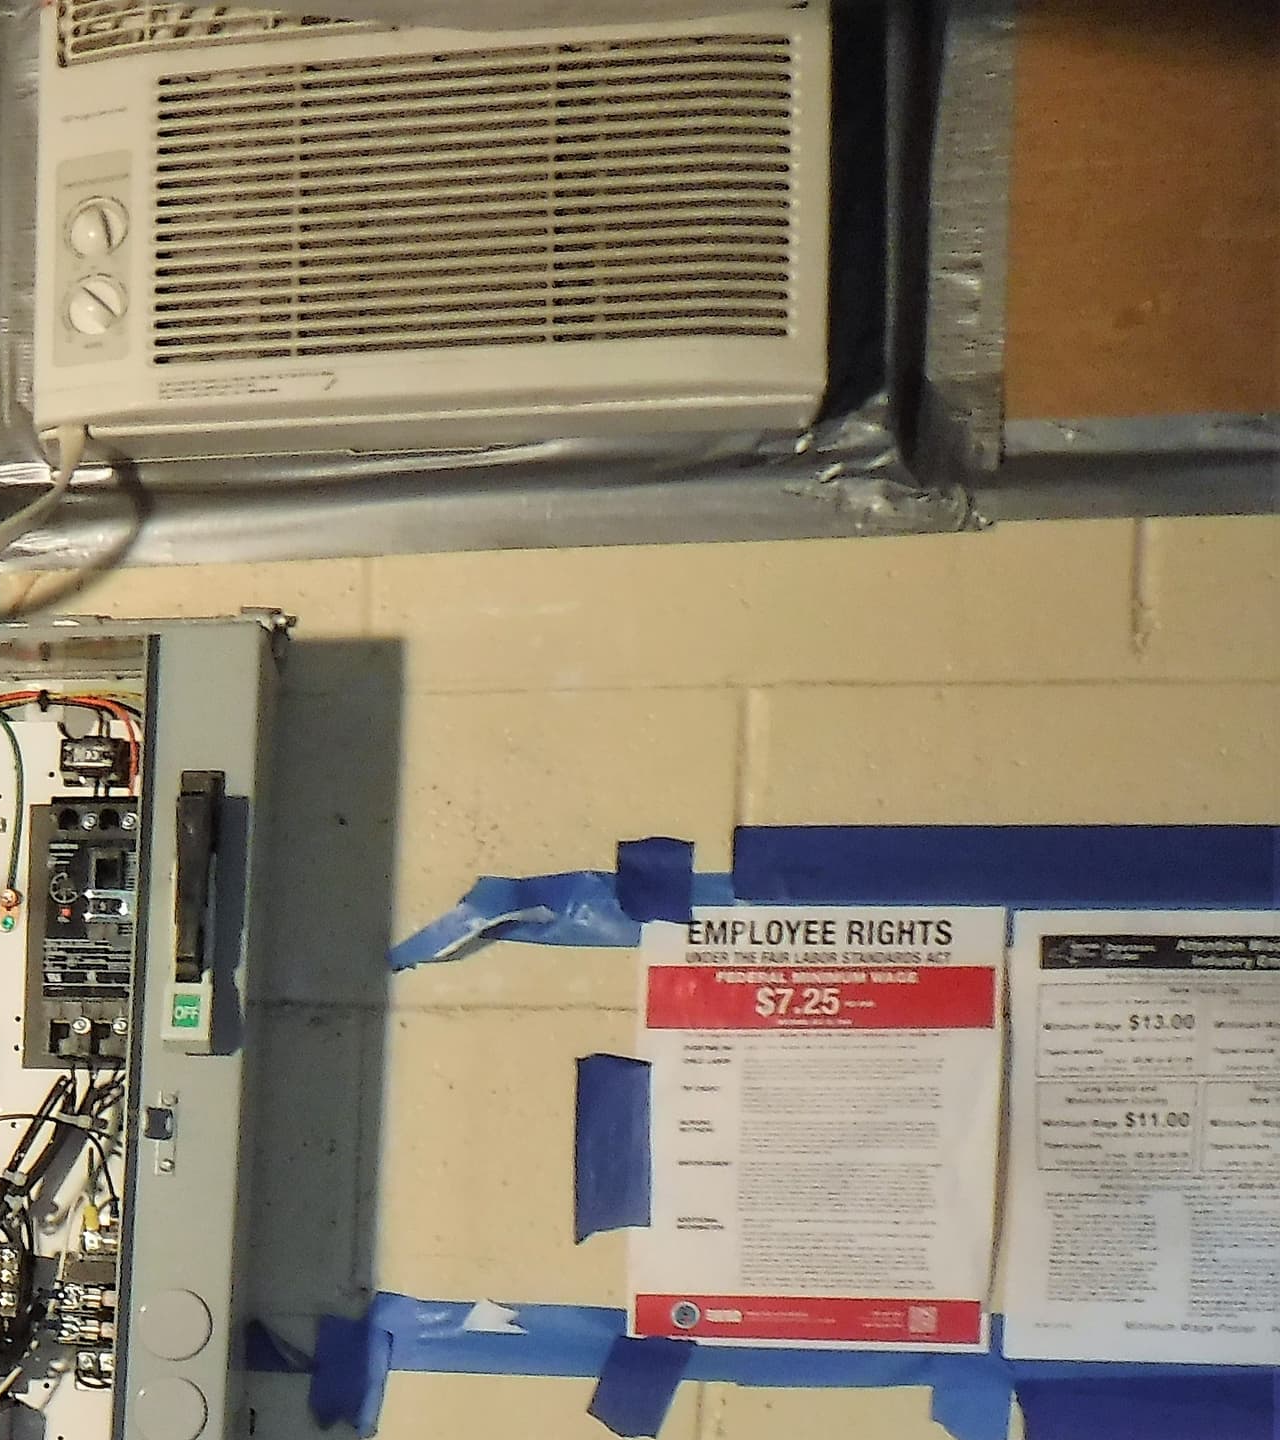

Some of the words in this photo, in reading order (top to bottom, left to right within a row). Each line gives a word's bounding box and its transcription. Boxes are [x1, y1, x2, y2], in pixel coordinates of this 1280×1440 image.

[687, 919, 836, 947] EMPLOYEE
[846, 919, 953, 947] RIGHTS
[685, 951, 728, 965] UNDER
[733, 951, 759, 965] THE
[761, 951, 789, 965] FAIR
[794, 951, 838, 965] LABOR
[926, 951, 951, 965] ACT
[754, 986, 841, 1017] $7.25
[174, 1004, 201, 1020] OFF
[1128, 1013, 1196, 1031] $13.00
[1124, 1111, 1191, 1129] $11.00
